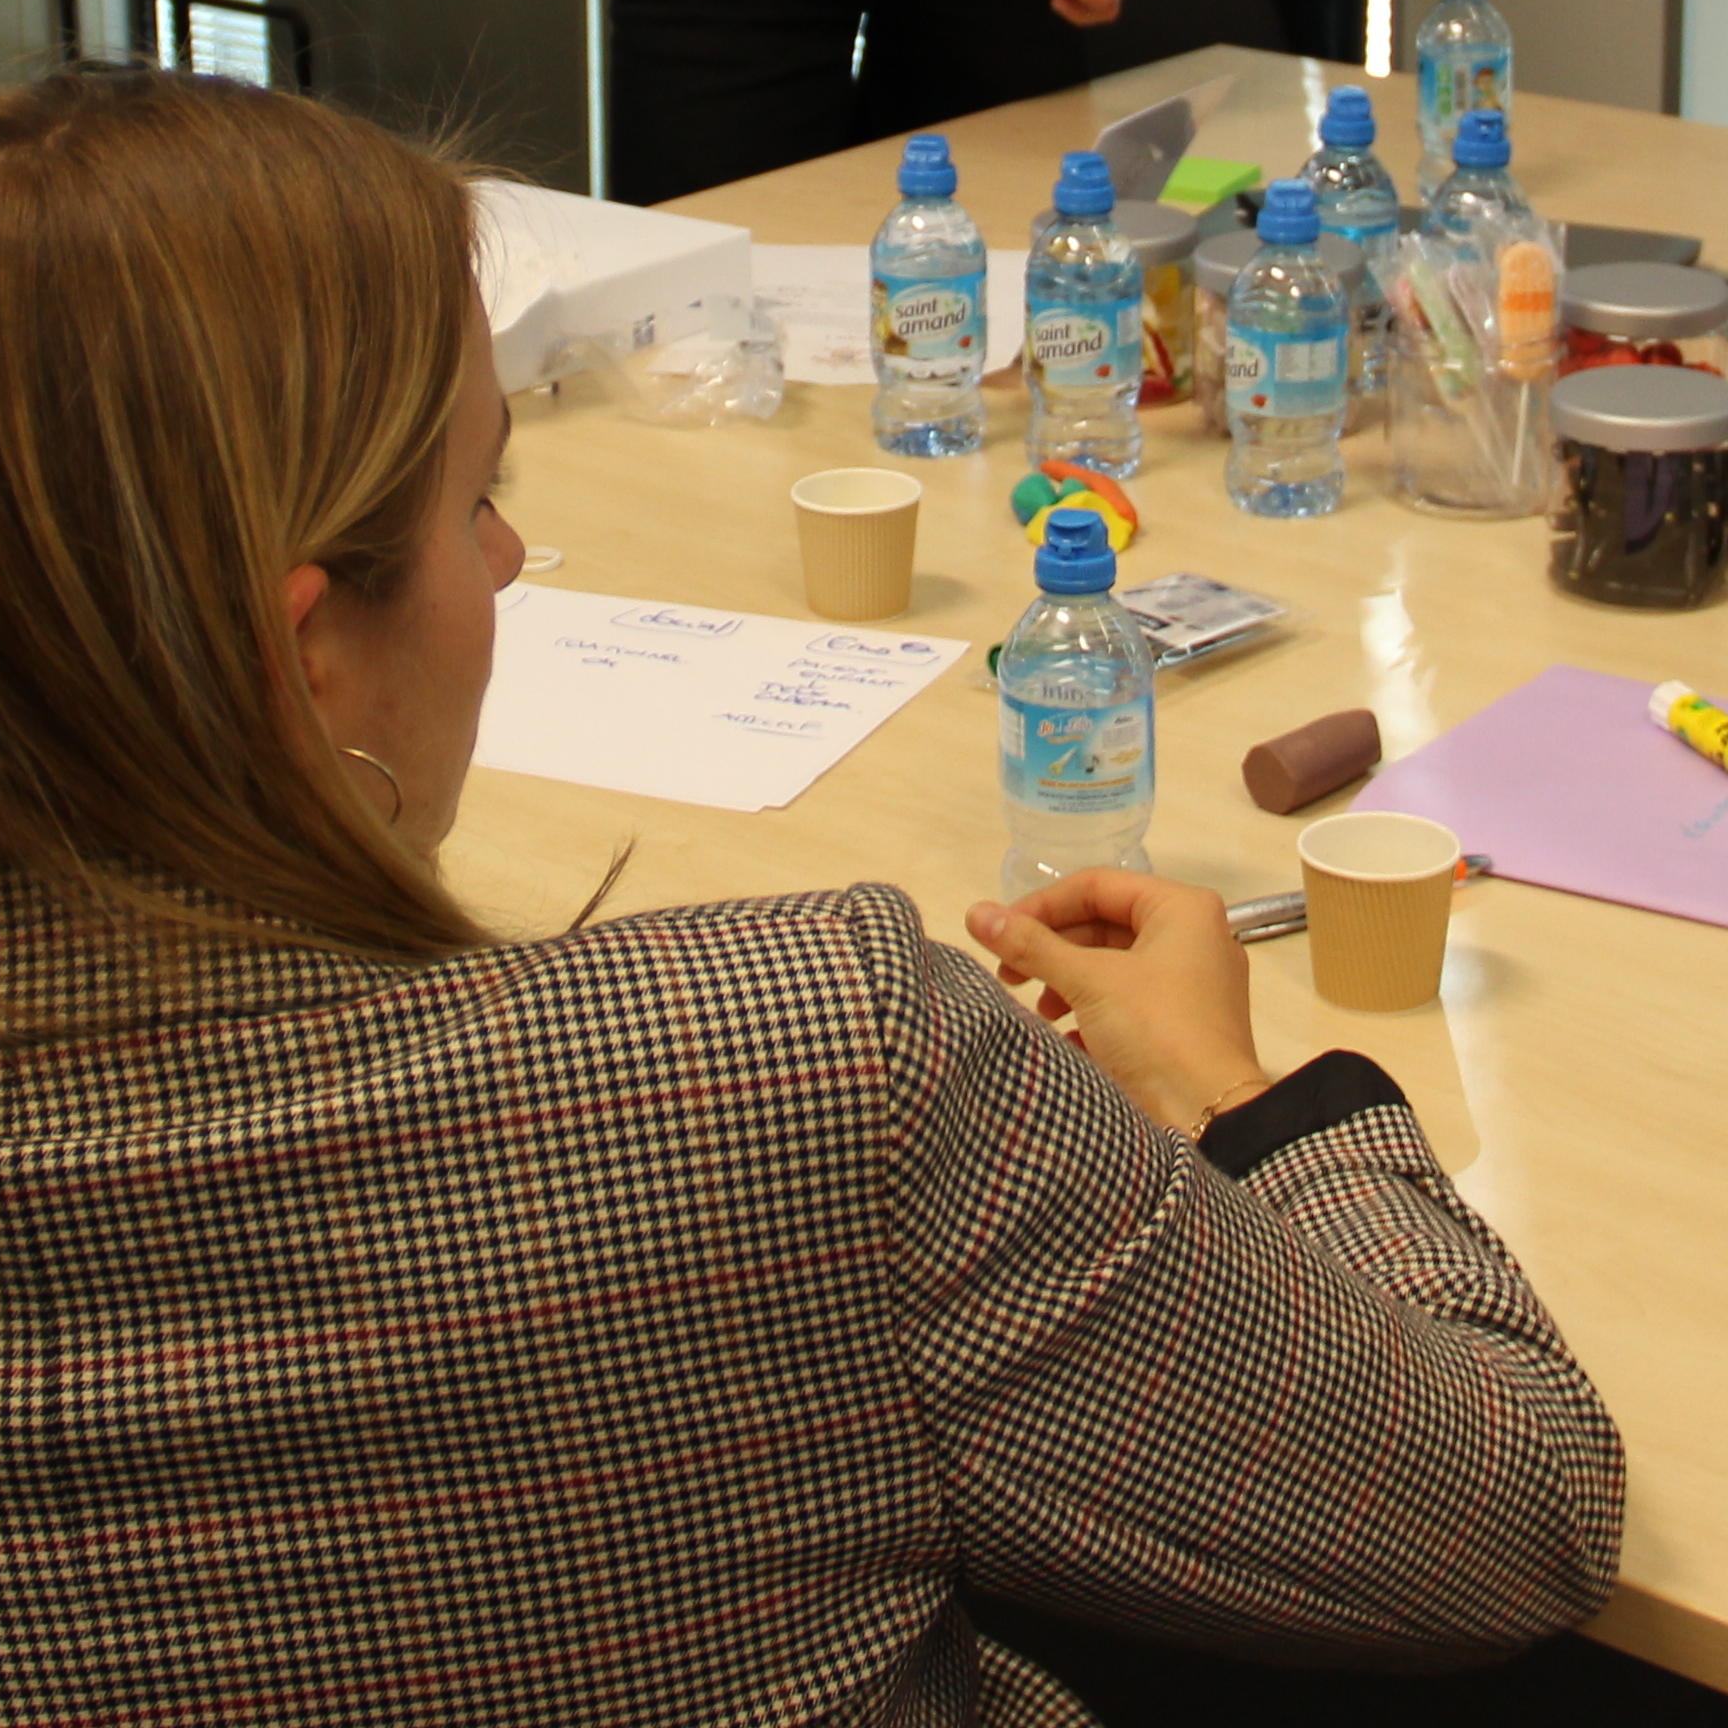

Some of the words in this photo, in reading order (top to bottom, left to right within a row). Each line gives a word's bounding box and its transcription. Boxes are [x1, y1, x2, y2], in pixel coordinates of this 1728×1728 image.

[895, 297, 937, 319] saint
[898, 302, 966, 336] amand
[1036, 329, 1102, 360] amand
